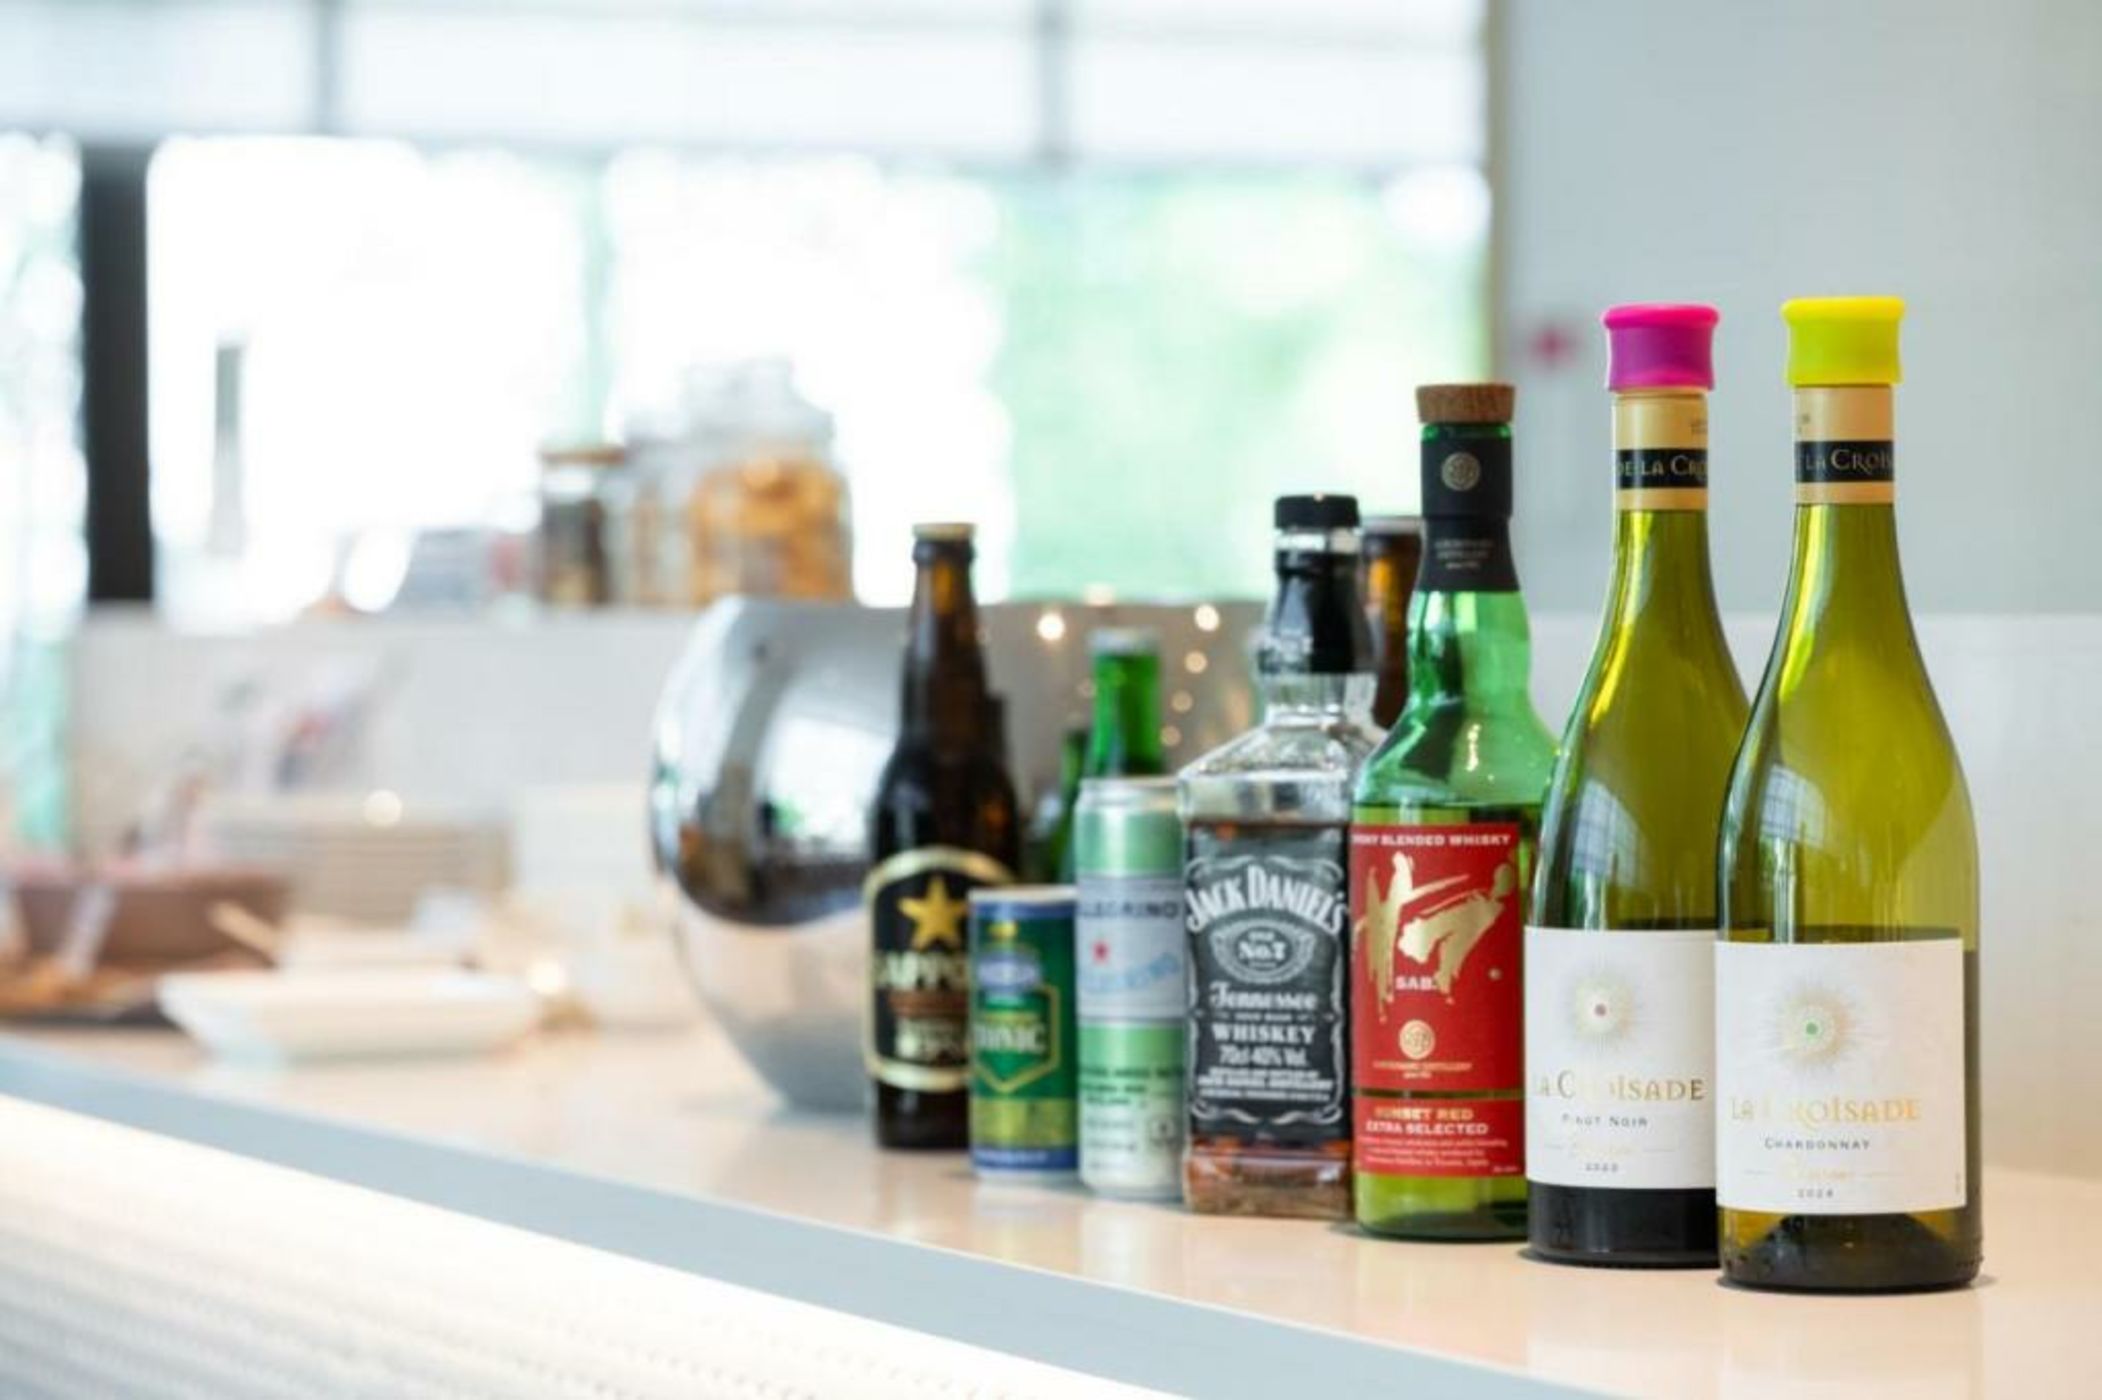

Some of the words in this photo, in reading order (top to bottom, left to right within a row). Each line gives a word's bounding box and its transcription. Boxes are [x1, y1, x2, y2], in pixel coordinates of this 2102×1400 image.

[1641, 459, 1665, 476] LA
[1380, 833, 1445, 846] BLENDED
[1449, 833, 1511, 846] WHISKY
[1184, 875, 1247, 933] JACK
[1247, 864, 1346, 936] DANIEL'S
[1209, 980, 1318, 1011] Tennessee
[1211, 1022, 1316, 1045] WHISKEY
[1436, 1107, 1475, 1121] RED
[1562, 1113, 1601, 1126] PNOT
[1366, 1120, 1403, 1134] EXTRA
[1405, 1122, 1489, 1136] SELECTED
[1764, 1136, 1871, 1150] CHARDONNAY
